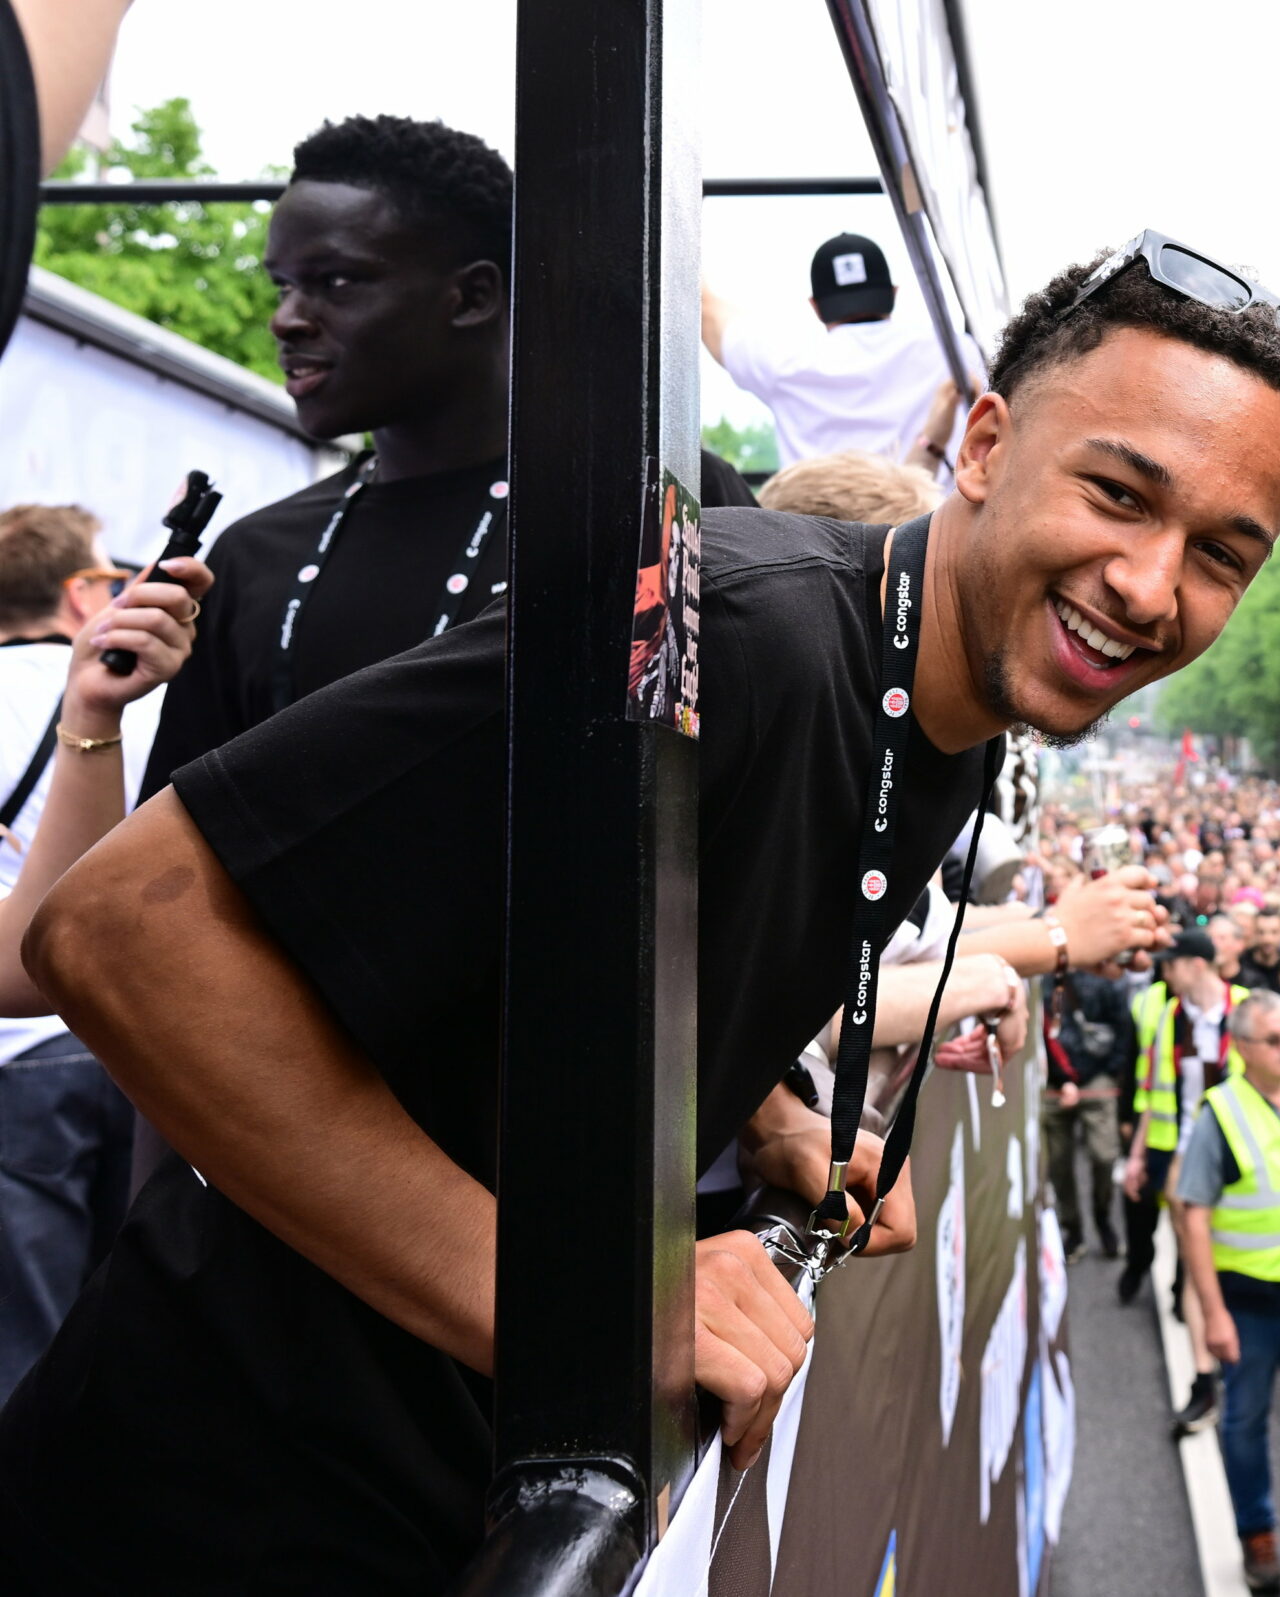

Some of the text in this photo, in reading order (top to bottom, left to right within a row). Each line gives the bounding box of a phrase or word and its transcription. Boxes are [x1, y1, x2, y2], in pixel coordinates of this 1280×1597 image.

[896, 571, 912, 632] congstar
[878, 748, 894, 815] congstar
[857, 940, 871, 1007] congstar
